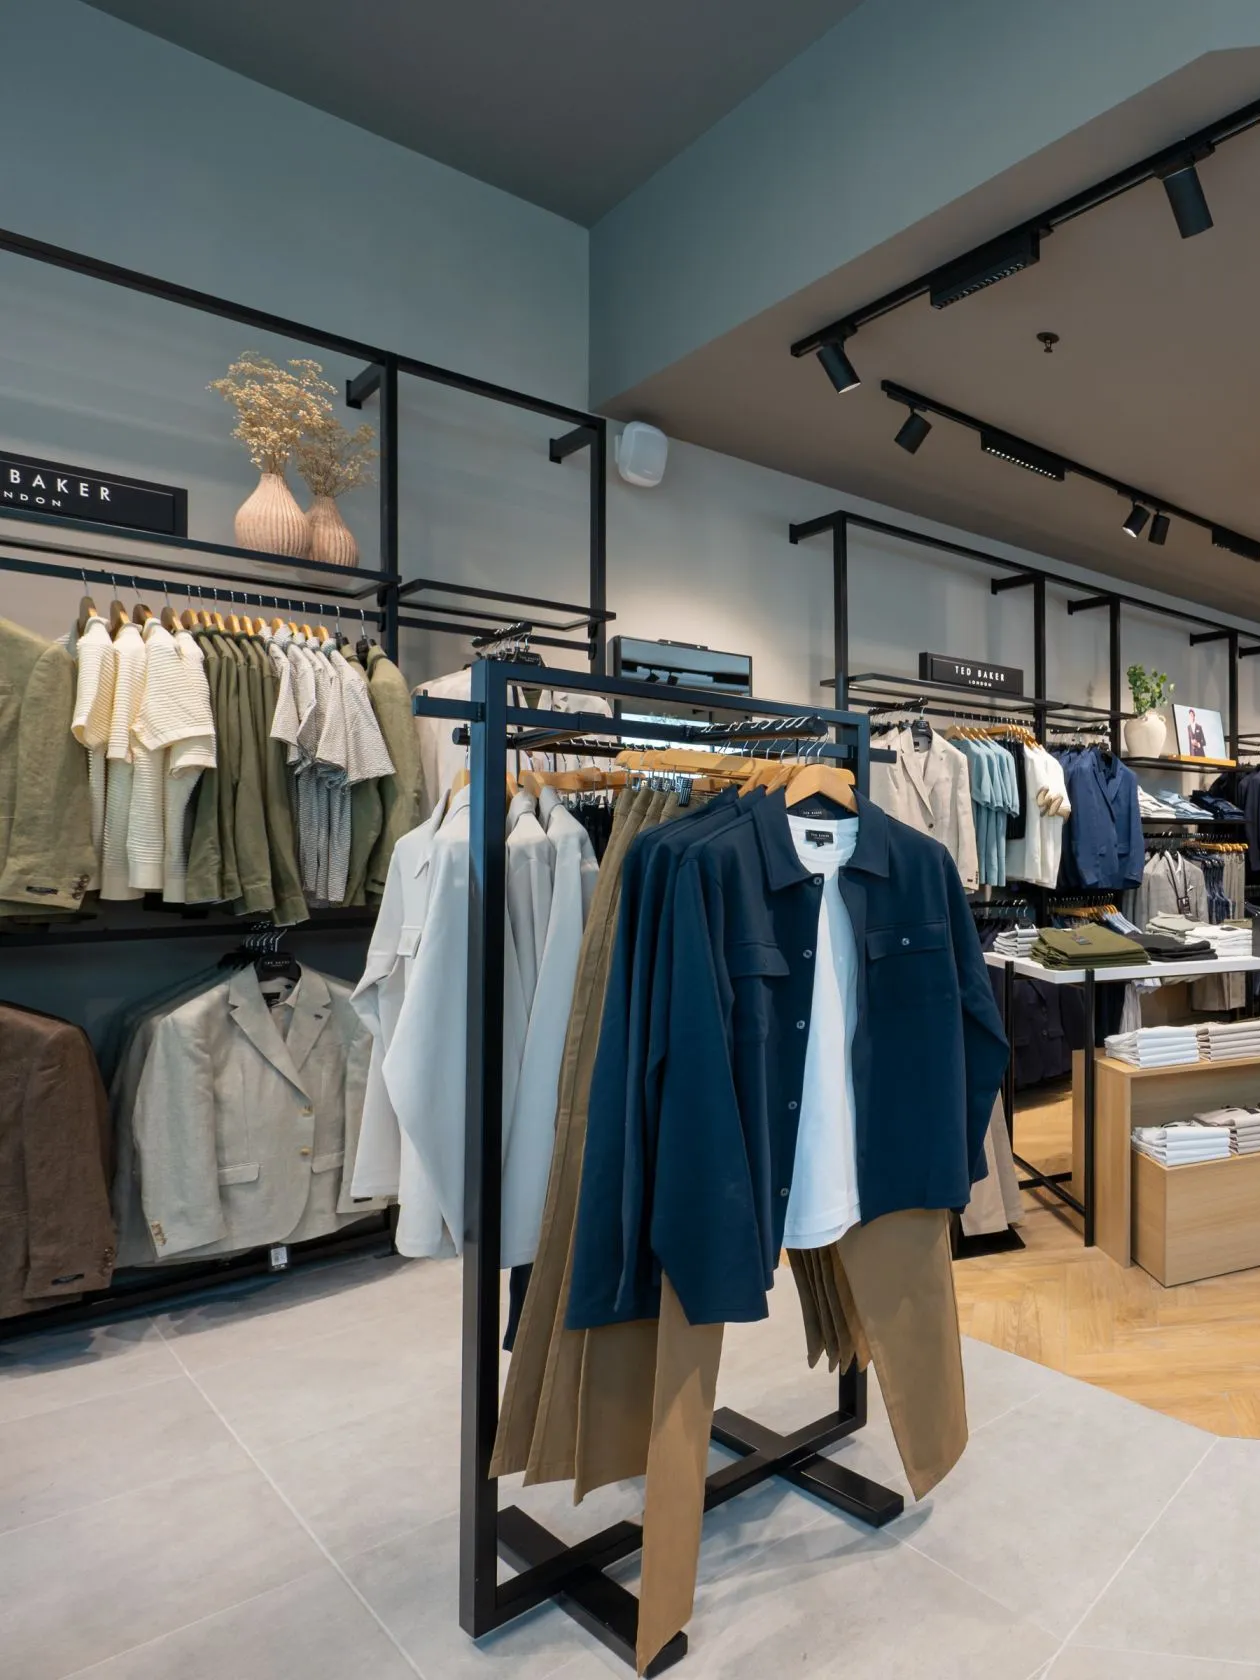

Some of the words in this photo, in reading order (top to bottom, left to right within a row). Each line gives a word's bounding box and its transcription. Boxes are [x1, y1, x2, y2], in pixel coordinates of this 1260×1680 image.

[9, 469, 112, 501] BAKER
[3, 490, 62, 507] NDON
[954, 665, 972, 676] TED
[977, 669, 1005, 682] BAKER
[968, 679, 993, 687] LONDON
